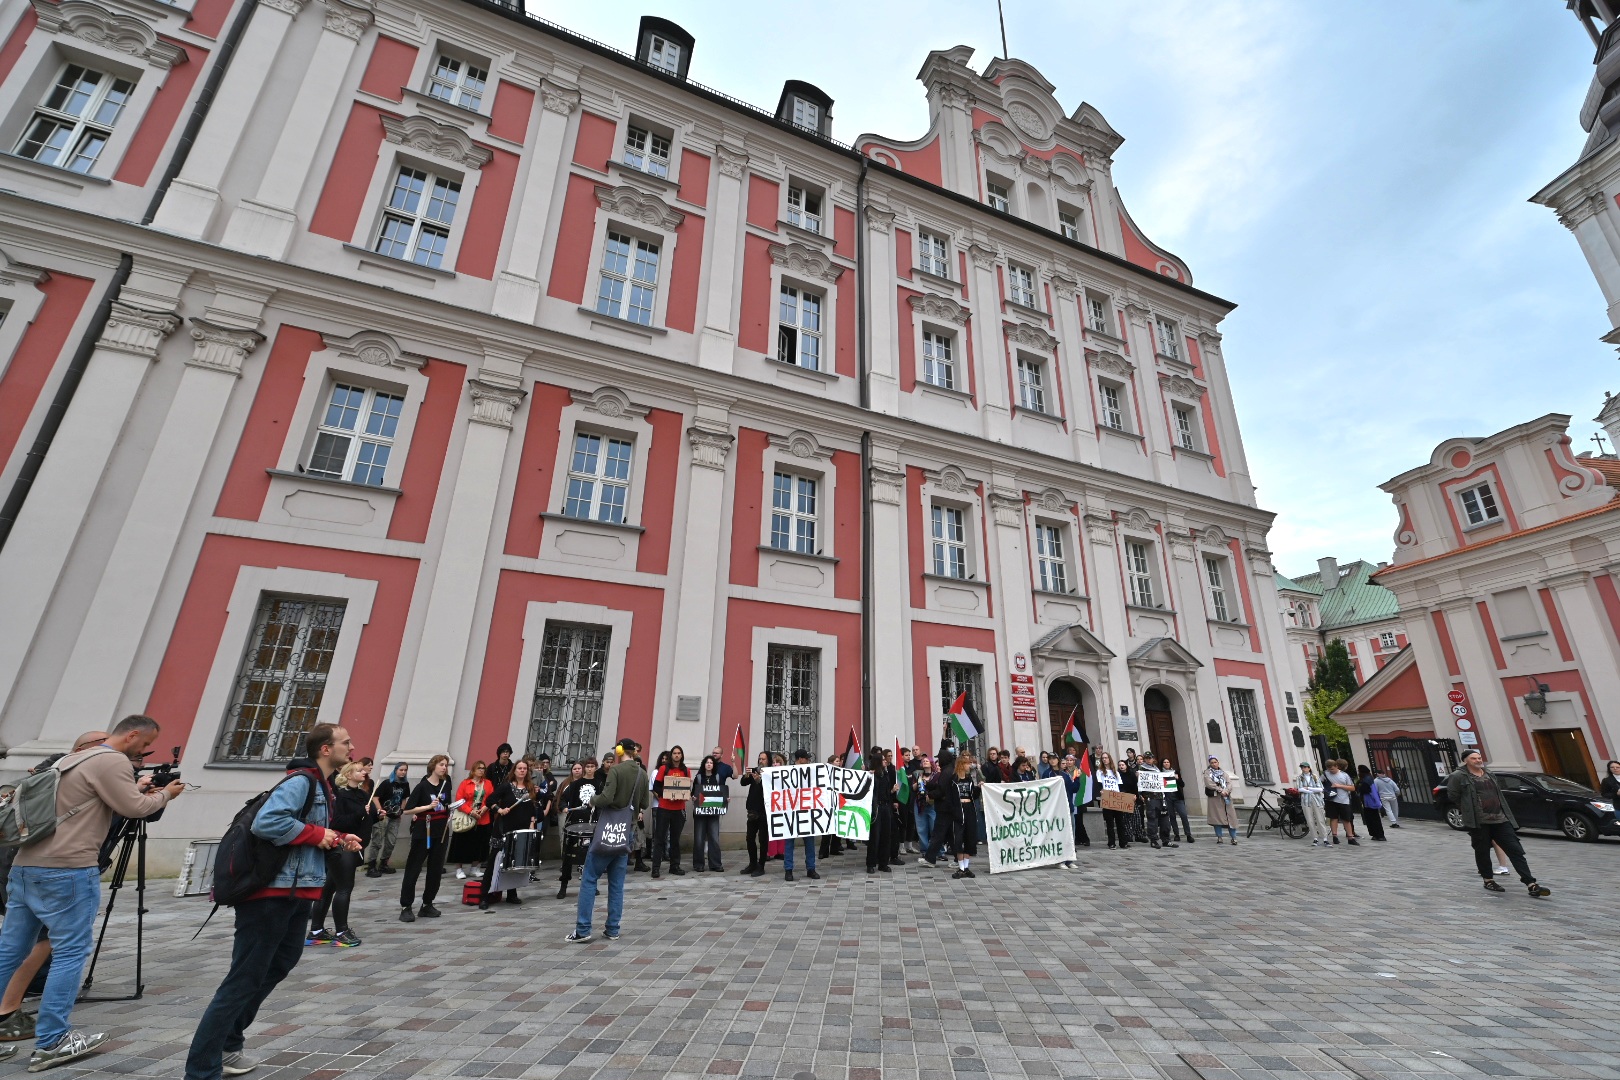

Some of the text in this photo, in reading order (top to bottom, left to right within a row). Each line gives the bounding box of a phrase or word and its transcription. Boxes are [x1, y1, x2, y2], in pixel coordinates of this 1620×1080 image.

[771, 766, 811, 791] FROM
[771, 787, 824, 812] RIVER
[1003, 786, 1051, 821] STOP
[1101, 799, 1134, 811] PALESTINE
[1108, 791, 1126, 800] FREE
[695, 806, 727, 815] PALESTYNA
[604, 822, 627, 833] MASZ
[770, 808, 859, 838] EVERY EA
[990, 817, 1065, 841] LUDOBÓJSTWU
[1000, 840, 1063, 866] PALESTYNIE
